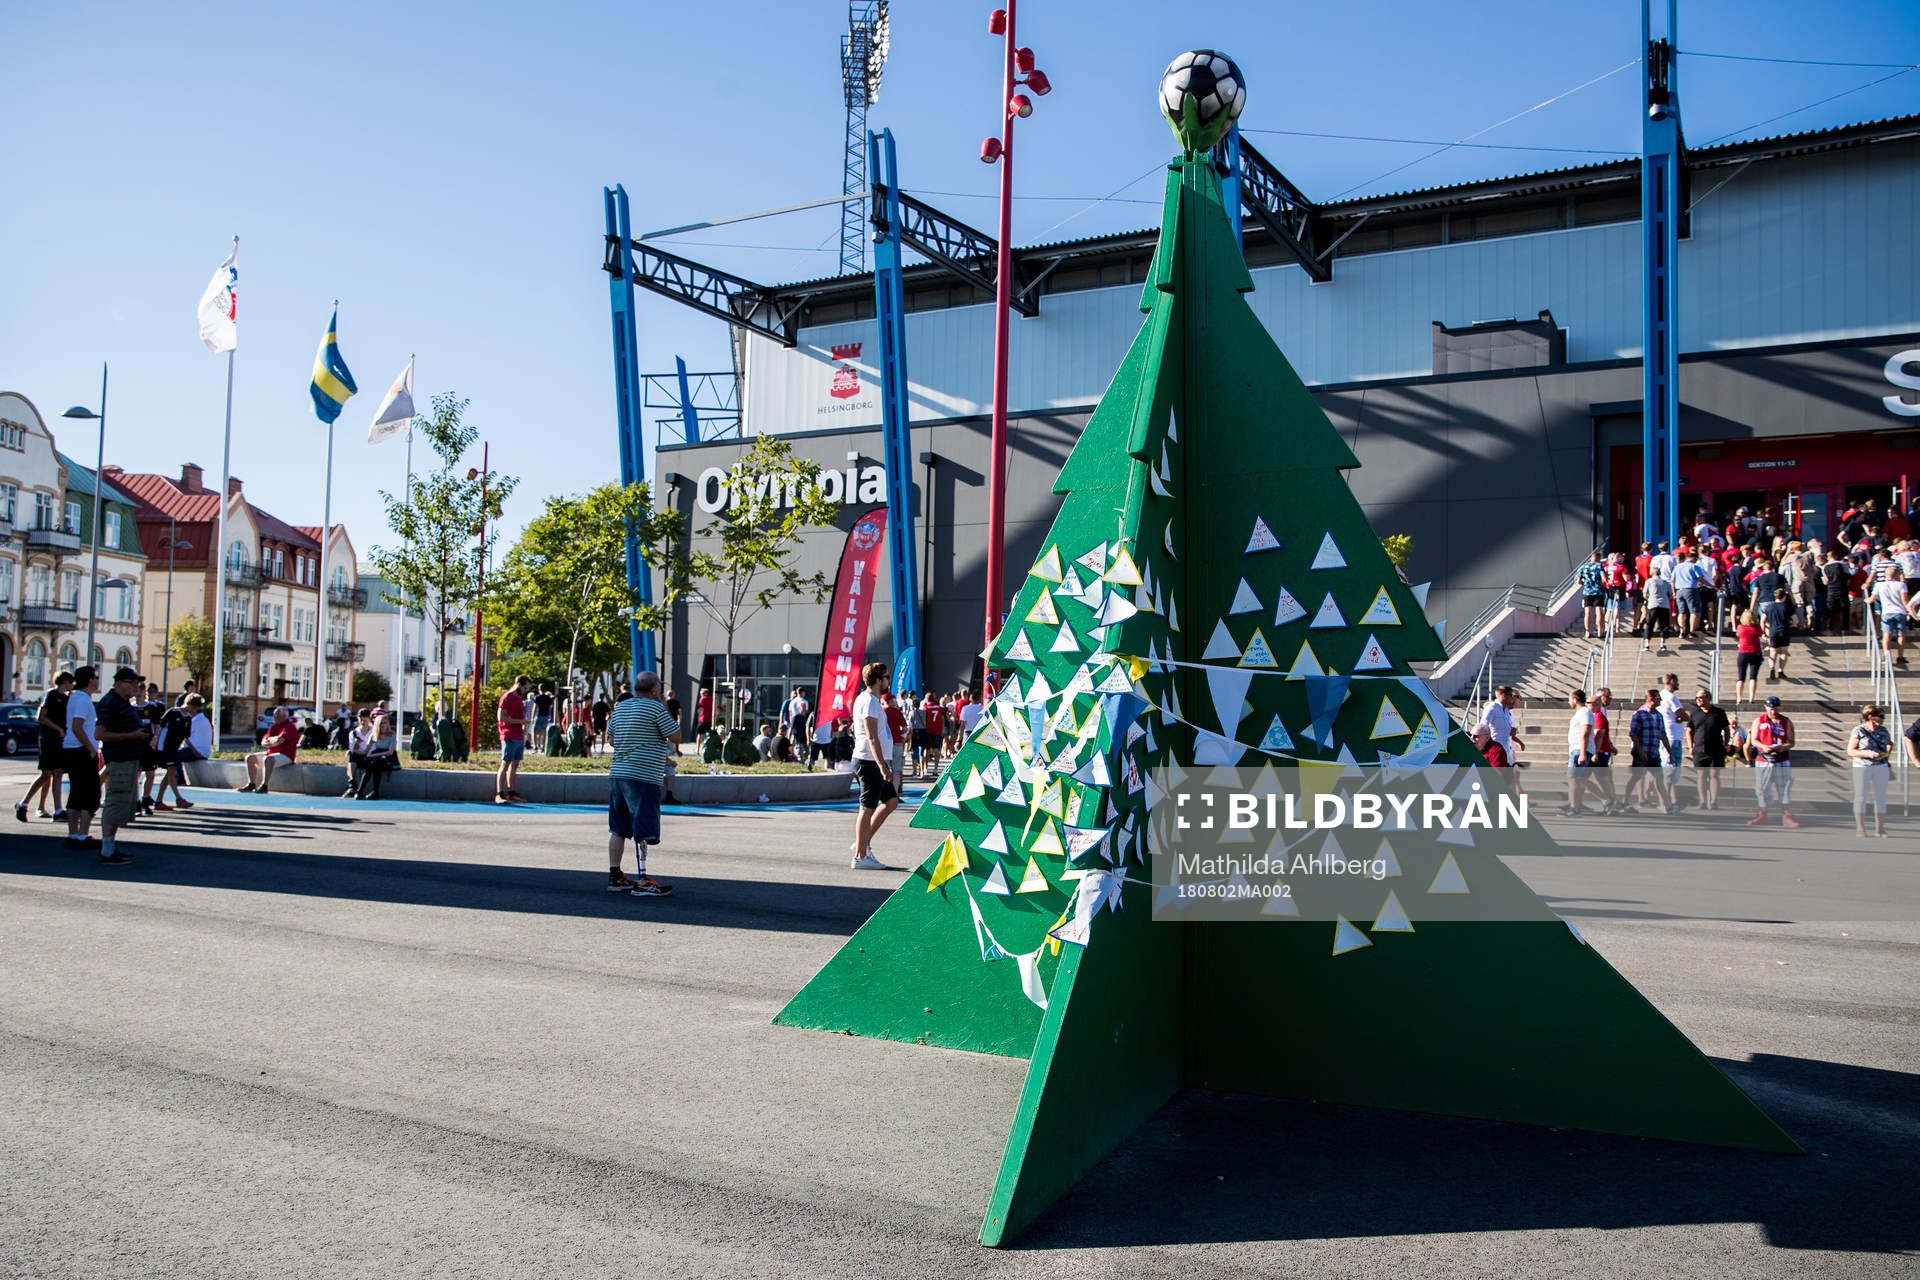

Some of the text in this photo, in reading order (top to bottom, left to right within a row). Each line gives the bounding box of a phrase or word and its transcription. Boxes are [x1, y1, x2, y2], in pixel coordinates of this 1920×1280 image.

[817, 401, 873, 414] HELSINGBORG
[831, 559, 866, 711] VÄLKOMNA
[931, 710, 939, 722] 7
